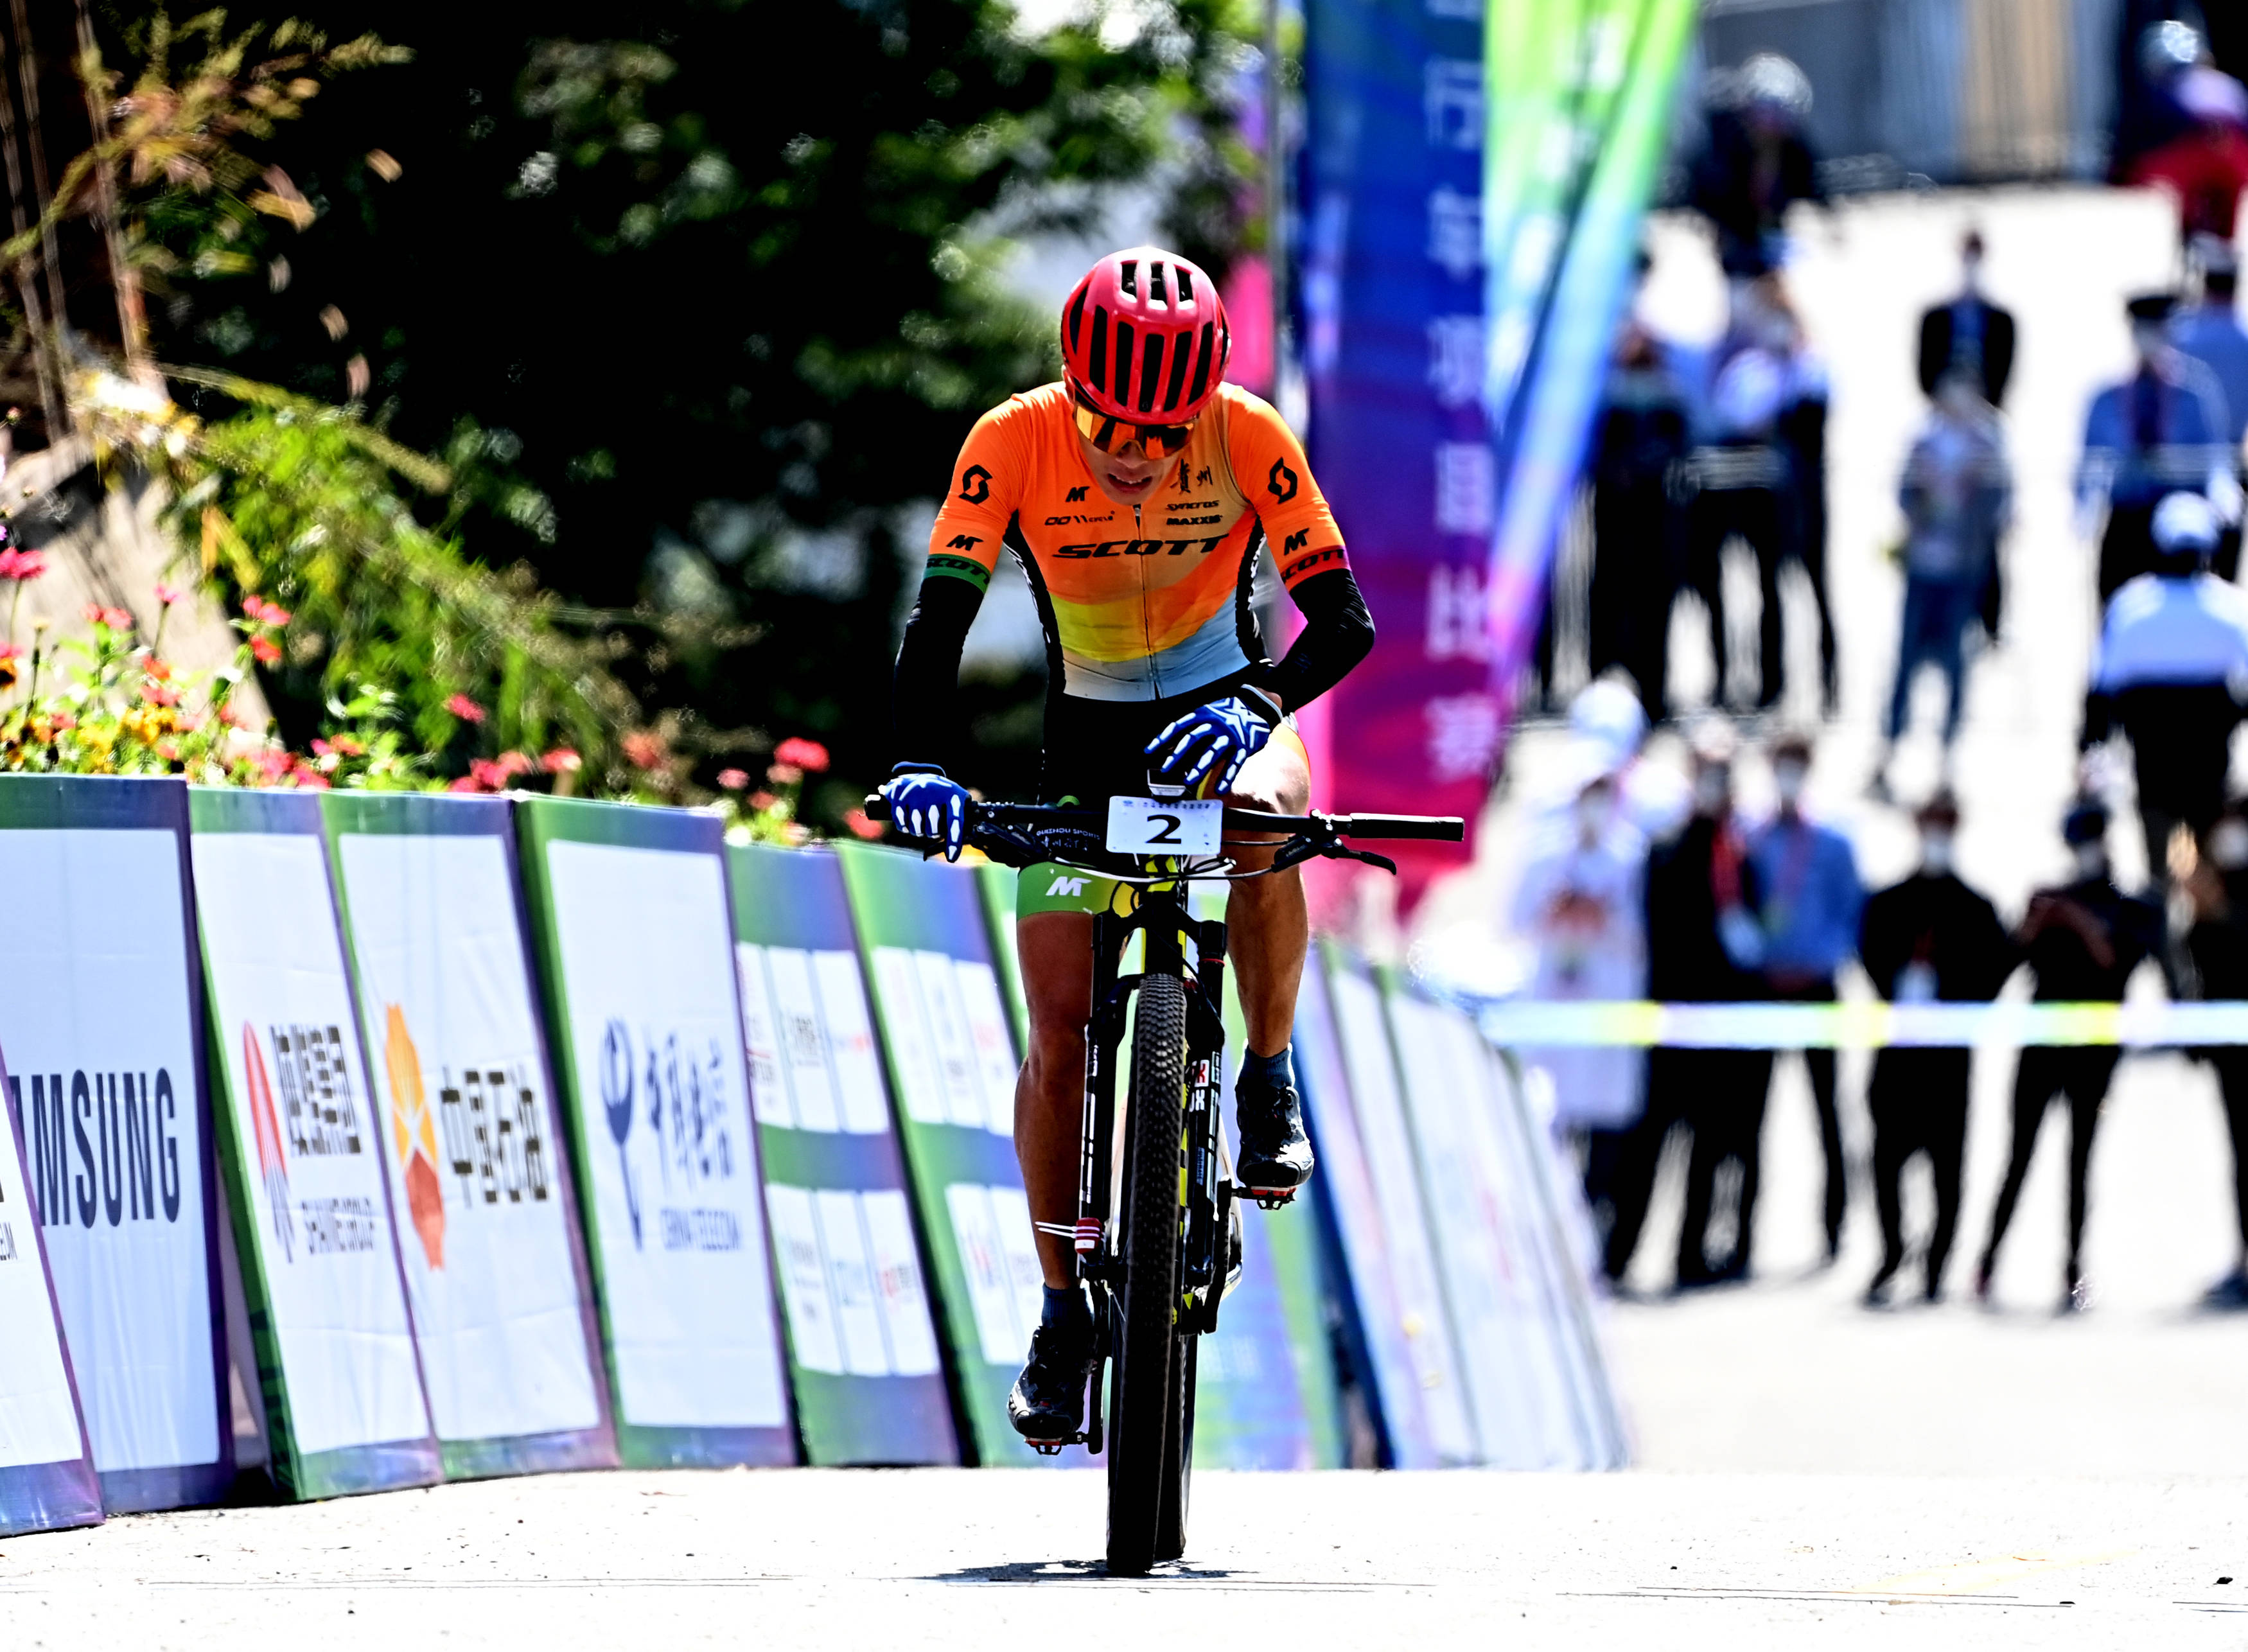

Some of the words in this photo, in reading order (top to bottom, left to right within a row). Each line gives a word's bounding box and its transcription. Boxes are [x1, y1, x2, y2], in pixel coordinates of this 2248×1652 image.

[1424, 0, 1498, 779] 行车项目比赛
[1052, 533, 1229, 558] SCOTT
[1145, 814, 1182, 844] 2
[8, 1068, 180, 1229] MSUNG
